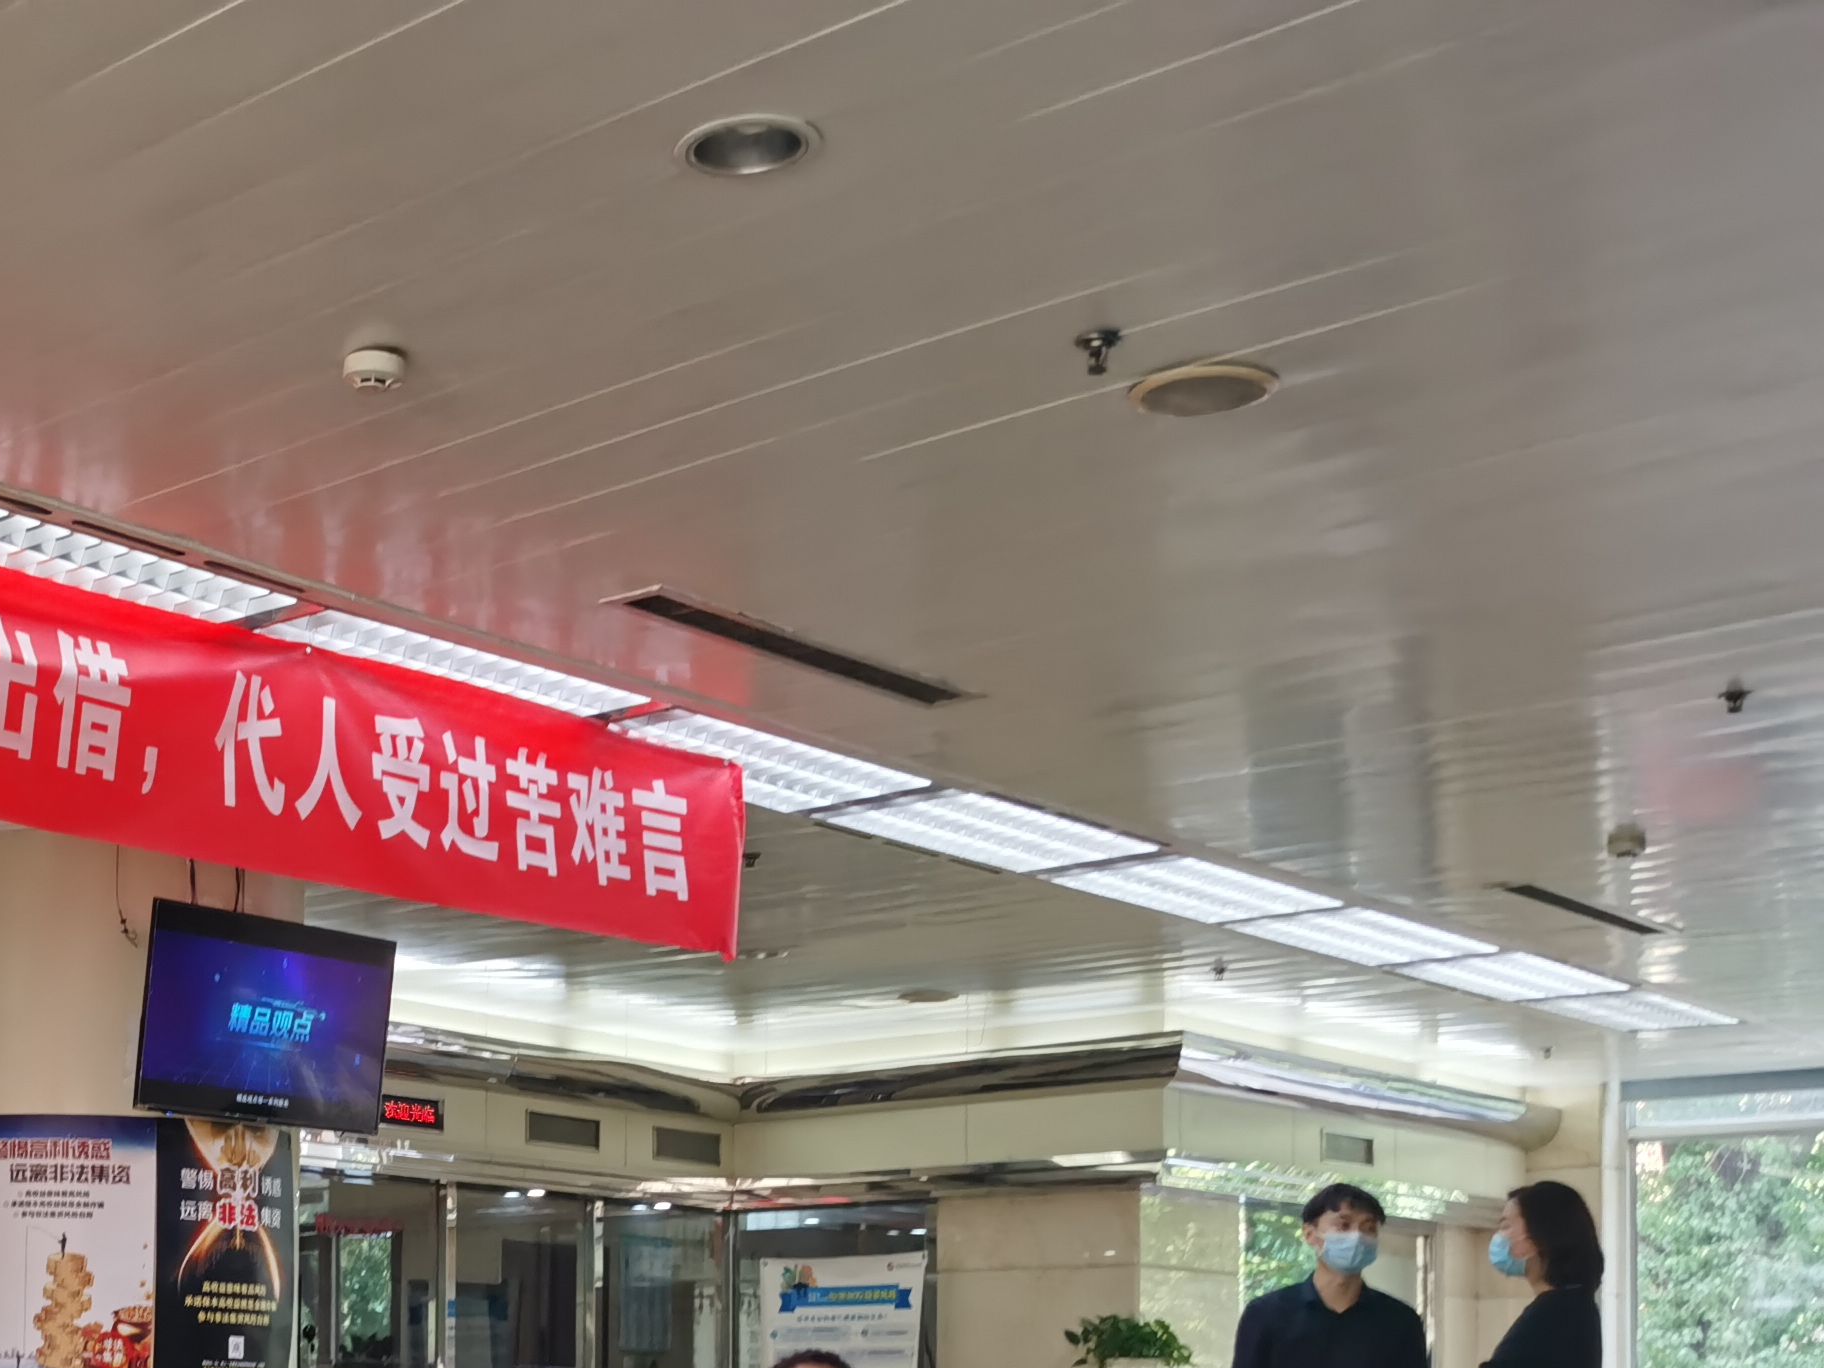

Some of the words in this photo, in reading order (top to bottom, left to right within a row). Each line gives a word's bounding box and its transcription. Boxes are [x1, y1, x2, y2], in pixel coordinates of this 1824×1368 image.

[228, 1002, 315, 1043] 精品观点
[384, 1100, 436, 1124] 欢迎光临
[9, 1163, 131, 1185] 远离非法集资
[179, 1164, 282, 1198] 警惕高利诱惑
[179, 1199, 282, 1232] 远离非法集资
